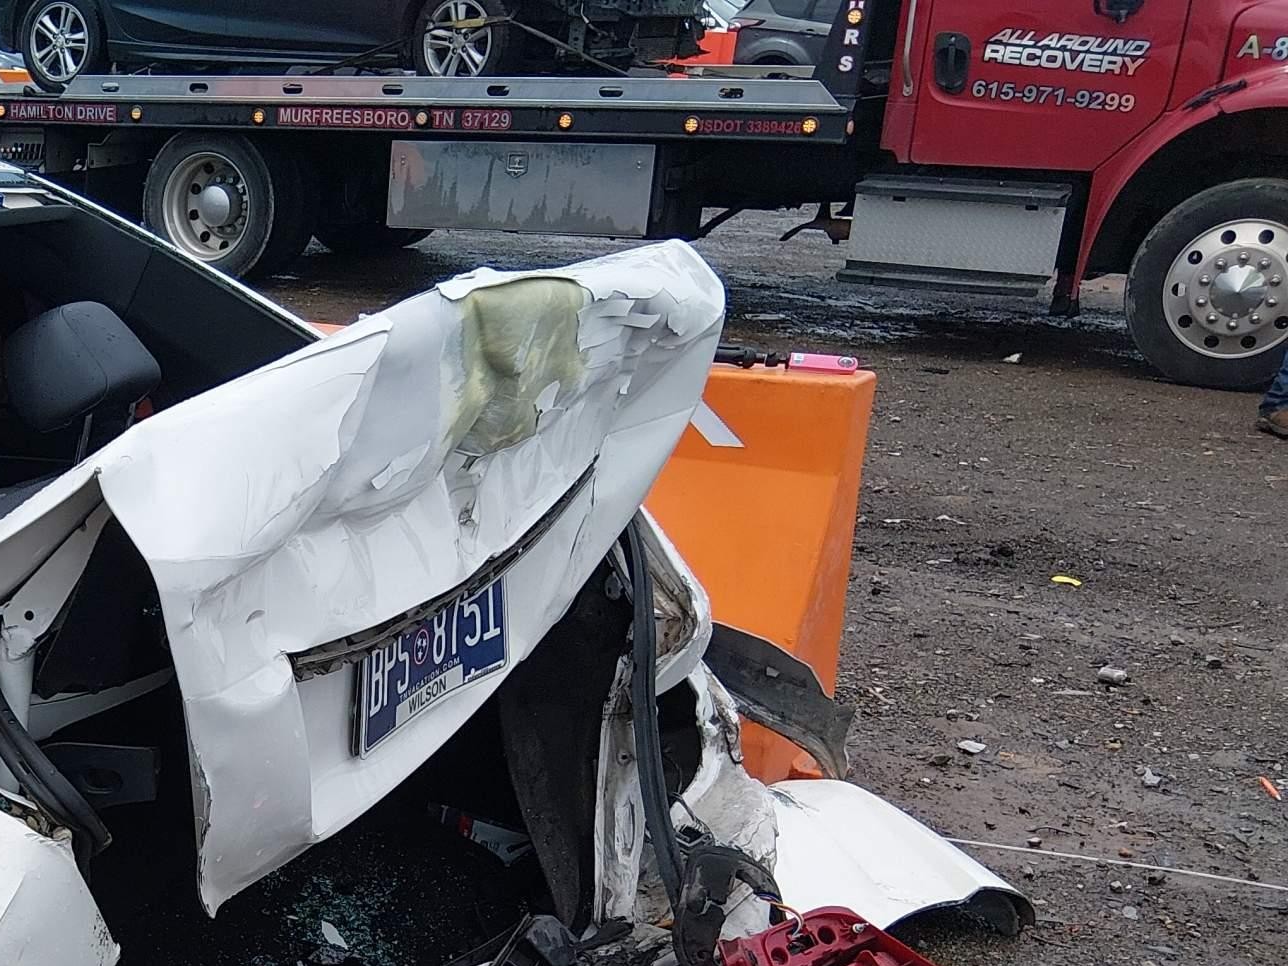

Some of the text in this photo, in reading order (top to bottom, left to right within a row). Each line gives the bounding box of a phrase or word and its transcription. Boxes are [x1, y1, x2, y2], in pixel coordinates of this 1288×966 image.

[987, 28, 1151, 56] ALL AROUND
[983, 43, 1145, 76] RECOVERY
[972, 80, 1135, 112] 615-971-9299
[11, 104, 73, 119] HAMILTON
[77, 106, 114, 121] DRIVE
[433, 111, 455, 126] TN
[463, 112, 510, 127] 37129
[408, 675, 447, 714] WILSON
